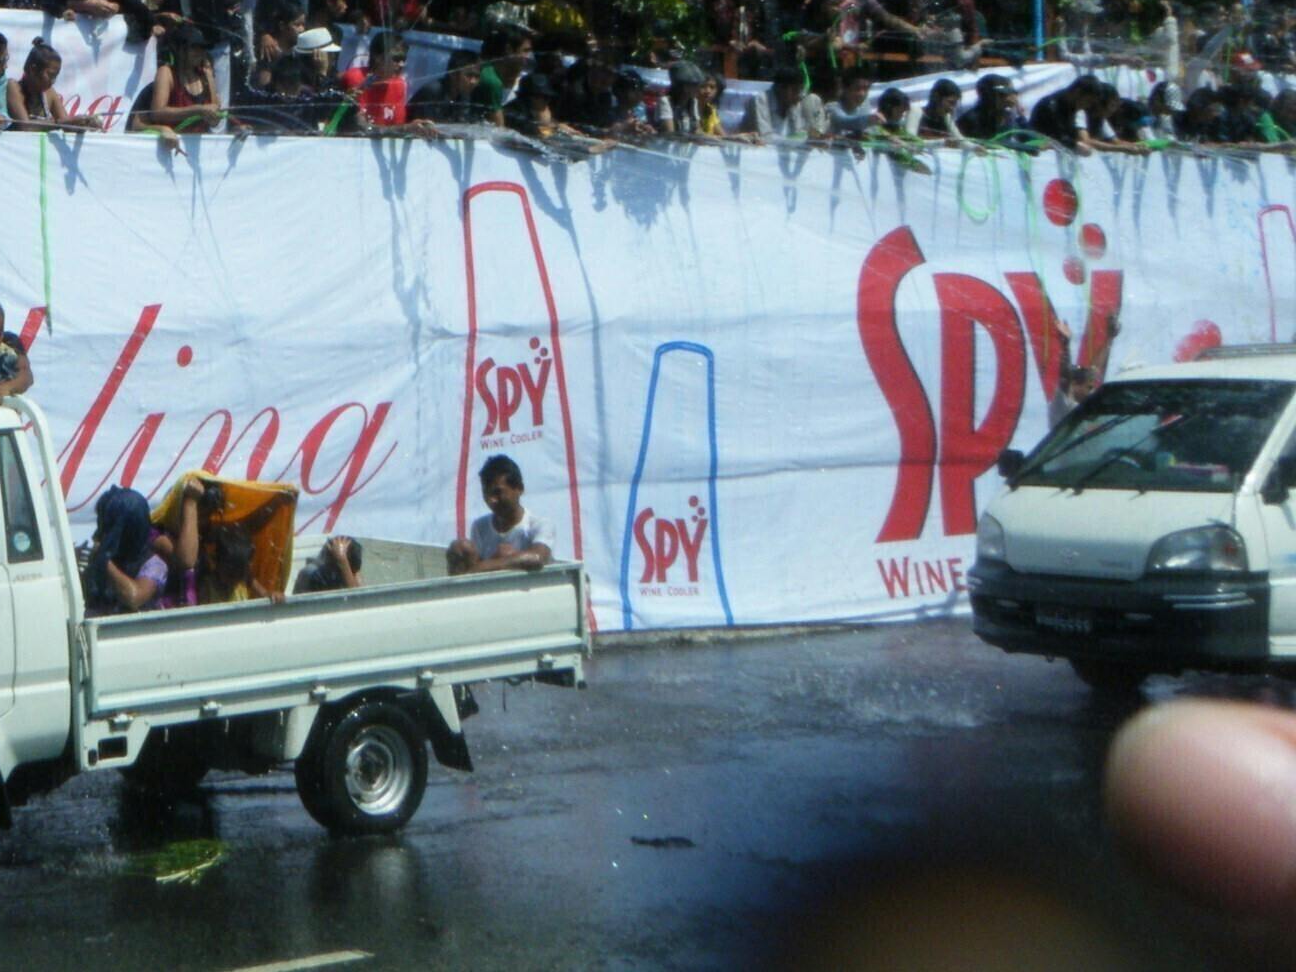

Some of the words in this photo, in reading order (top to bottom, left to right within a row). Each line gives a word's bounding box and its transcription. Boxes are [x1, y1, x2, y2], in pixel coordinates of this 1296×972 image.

[475, 350, 552, 437] SPY
[857, 218, 1124, 543] SPY
[510, 430, 543, 445] COOLER
[633, 503, 708, 583] SPY
[876, 556, 971, 599] WINE
